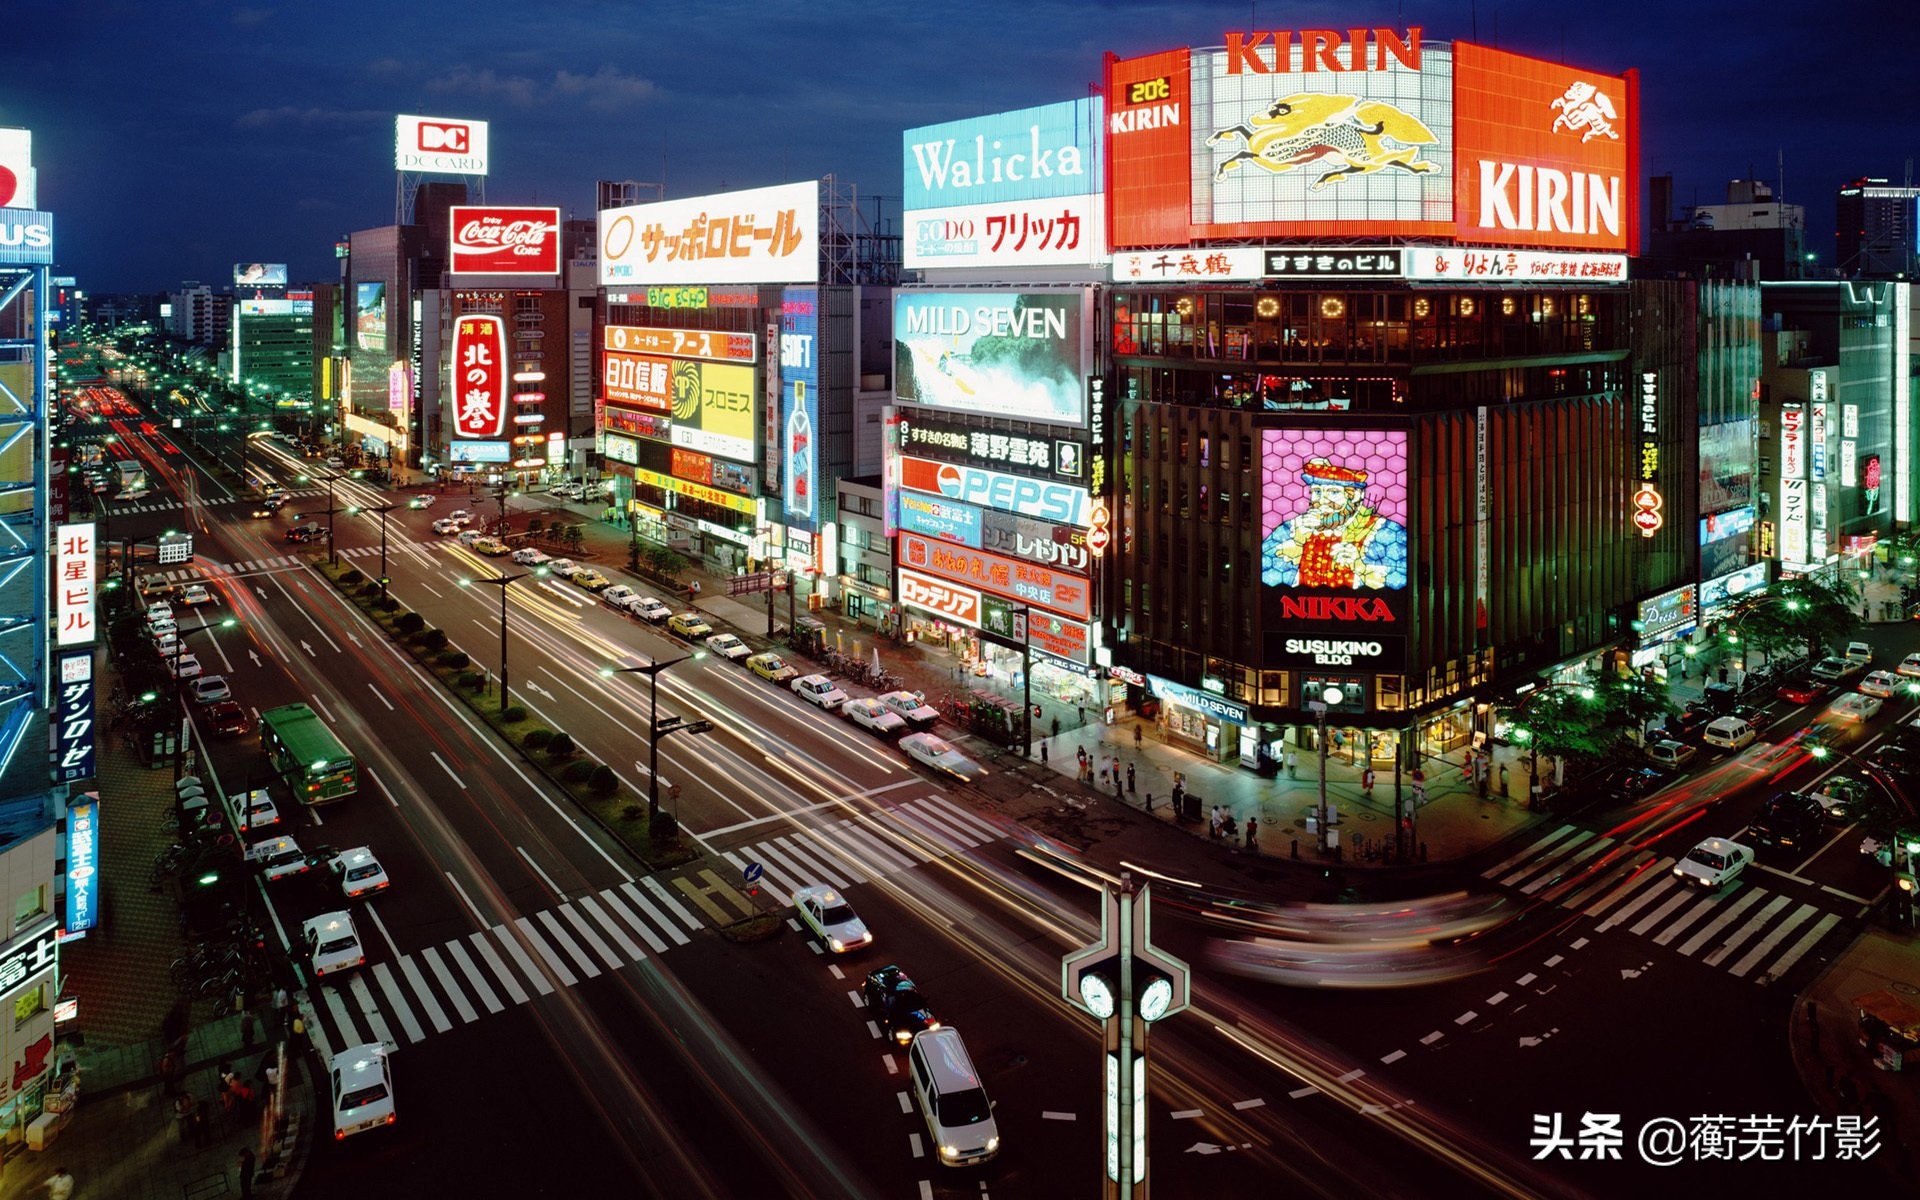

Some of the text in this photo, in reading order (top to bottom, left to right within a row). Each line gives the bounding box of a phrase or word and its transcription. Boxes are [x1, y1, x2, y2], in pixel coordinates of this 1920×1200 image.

[1225, 27, 1423, 75] KIRIN
[1111, 103, 1180, 134] KIRIN
[423, 125, 466, 150] DC
[405, 154, 483, 170] DC CARD
[912, 124, 1084, 191] Walicka
[1478, 160, 1621, 237] KIRIN
[459, 220, 548, 245] Coca-Cola
[482, 216, 502, 225] Enjoy
[986, 209, 1081, 252] ワリッカ
[641, 208, 803, 263] サッポロビール
[513, 244, 543, 256] Coke
[1271, 255, 1395, 271] すすきのビル
[1152, 252, 1233, 276] 千歳鶴
[1435, 255, 1450, 273] 8F
[1463, 253, 1518, 275] りょん亭
[648, 287, 671, 310] BIG
[676, 287, 707, 310] ECHO
[784, 316, 796, 331] Hi
[907, 305, 1066, 340] MILD SEVEN
[672, 331, 712, 357] アース
[781, 333, 813, 369] SOFT
[606, 357, 668, 395] 日立信販
[911, 427, 968, 450] すすきの名物店
[1784, 410, 1802, 441] ゼブラ
[959, 469, 1084, 527] PEPSI
[1785, 495, 1803, 522] ワイド
[63, 536, 91, 632] 北星ビル
[901, 576, 974, 616] ロッテリア
[1015, 582, 1051, 604] 中央店
[1054, 582, 1082, 604] 2F
[1280, 595, 1396, 621] NIKKA
[1285, 638, 1383, 656] SUSUKINO
[1315, 654, 1352, 666] BLDG
[1183, 691, 1244, 721] MILD SEVEN
[61, 682, 92, 768] サンローゼ
[65, 767, 87, 779] B1
[71, 829, 92, 868] 武富士
[73, 919, 89, 931] 2F
[0, 939, 55, 989] 富士
